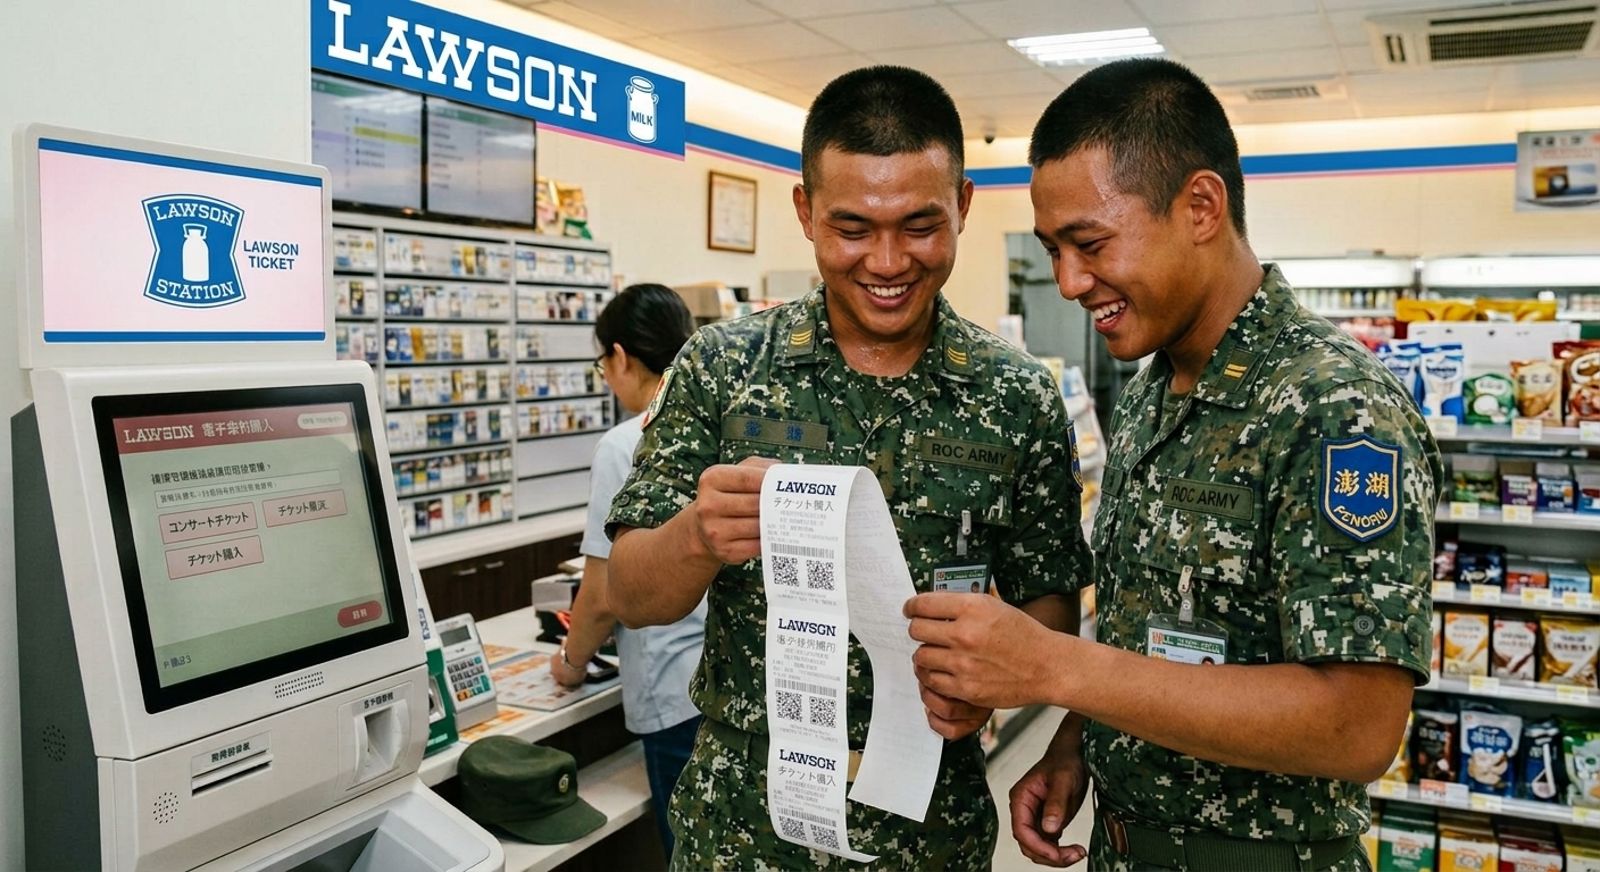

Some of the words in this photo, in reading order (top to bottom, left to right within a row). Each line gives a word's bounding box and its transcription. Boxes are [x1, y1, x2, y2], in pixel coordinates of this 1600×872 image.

[327, 1, 598, 122] LAWSON
[631, 110, 653, 127] MILK
[153, 202, 235, 227] LAWSON
[243, 240, 299, 256] LAWSON
[249, 255, 295, 270] TICKET
[156, 279, 235, 300] STATION
[124, 425, 194, 443] LAWSON
[931, 443, 964, 458] ROC
[967, 448, 1007, 465] ARMY
[776, 480, 837, 496] LAWSON
[1333, 468, 1390, 499] 澎湖
[1171, 485, 1196, 503] ROC
[1196, 489, 1240, 510] ARMY
